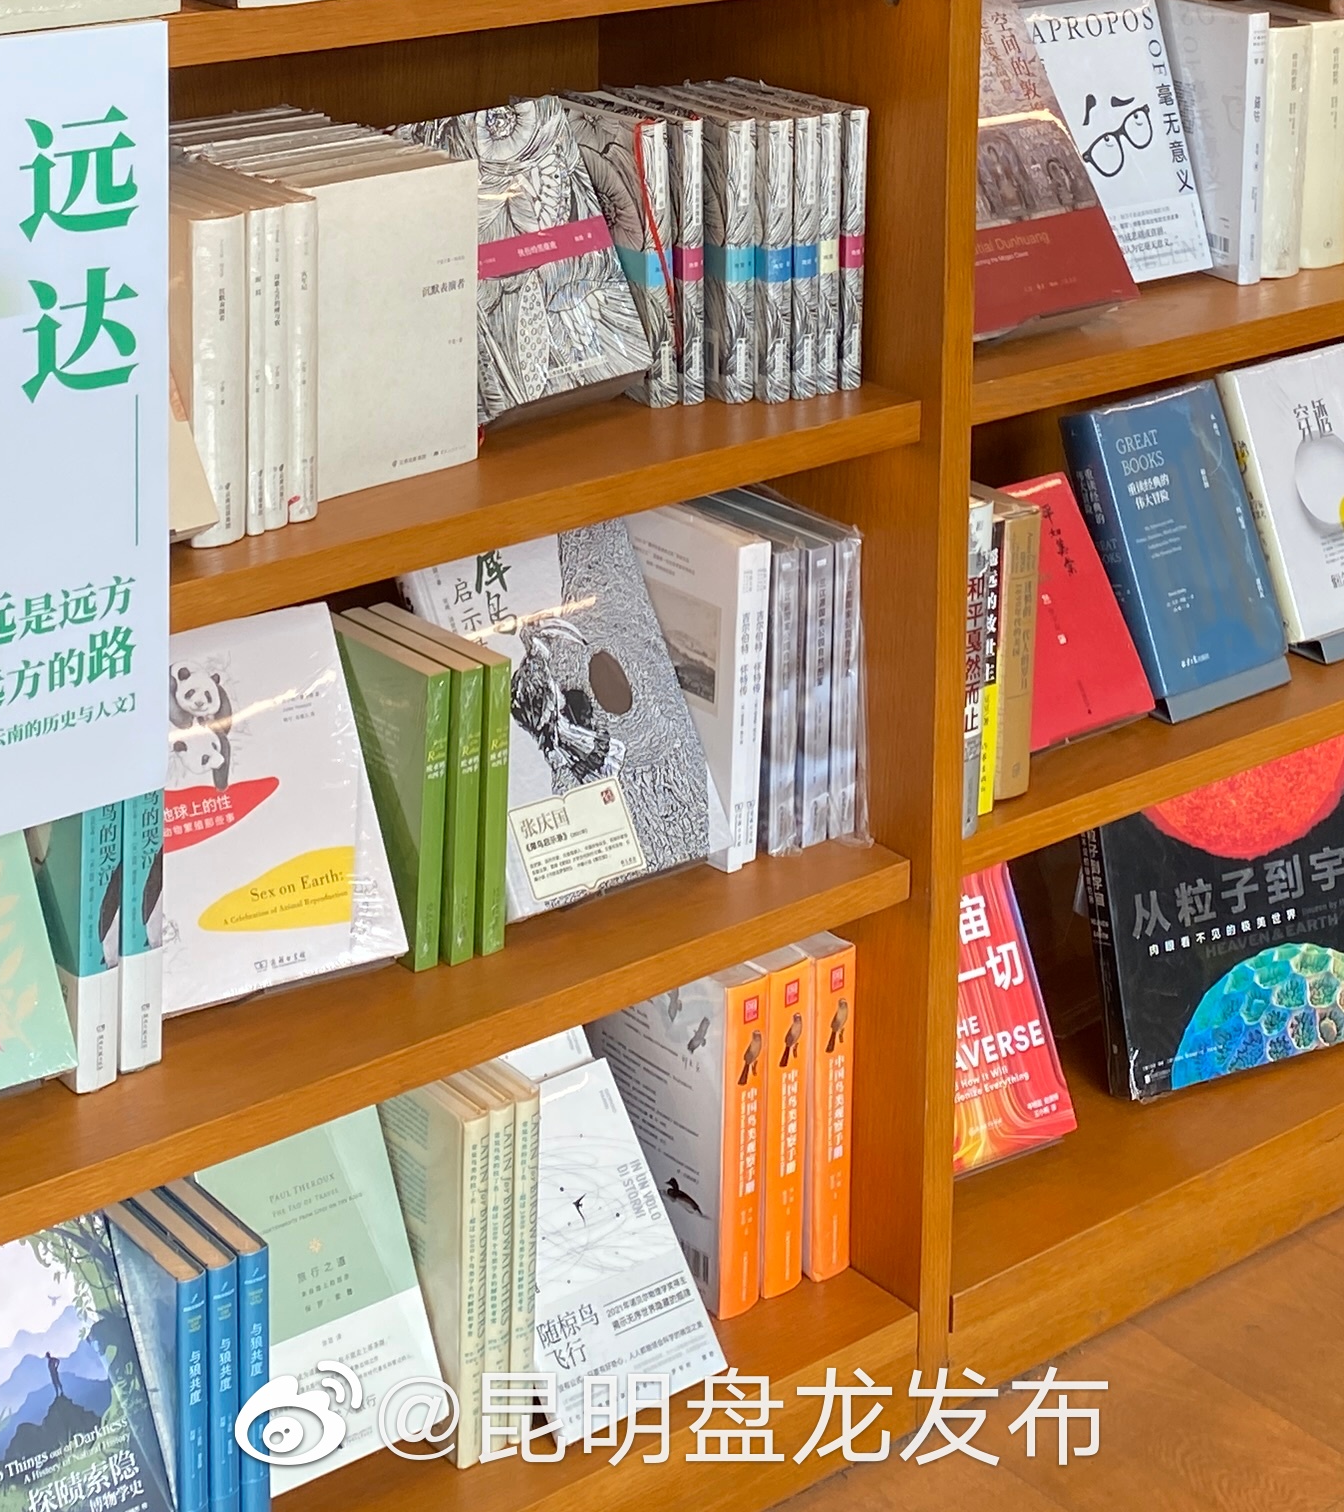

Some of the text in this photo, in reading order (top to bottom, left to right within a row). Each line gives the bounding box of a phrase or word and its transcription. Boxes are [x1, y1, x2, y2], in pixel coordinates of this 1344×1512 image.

[1030, 6, 1155, 45] APROPOS
[1153, 82, 1195, 194] 毫无意义
[18, 104, 140, 405] 远达
[420, 278, 467, 299] 沉默表演者
[1115, 428, 1160, 455] GREAT
[1121, 450, 1165, 477] BOOKS
[1127, 472, 1171, 497] 重读经典的
[1135, 491, 1171, 511] 伟大冒险
[163, 794, 233, 823] 地球上的性
[519, 807, 571, 839] 张庆国
[249, 869, 346, 903] Sex on Earth:
[1148, 907, 1299, 958] 肉眼看不见的极美世界
[1205, 929, 1270, 960] HEAVEN
[1284, 913, 1340, 938] EARTH
[984, 1072, 1031, 1098] Everything
[616, 1164, 647, 1220] DI STORNI
[629, 1158, 642, 1172] IN
[643, 1190, 662, 1222] VOLO
[535, 1302, 600, 1350] 随椋鸟
[219, 1337, 233, 1393] 与狼共度
[544, 1338, 588, 1372] 飞行
[188, 1350, 203, 1406] 与狼共度
[5, 1449, 50, 1479] Things
[49, 1447, 63, 1462] out
[73, 1416, 129, 1447] Darkness
[32, 1461, 63, 1481] History
[71, 1445, 104, 1465] Natural
